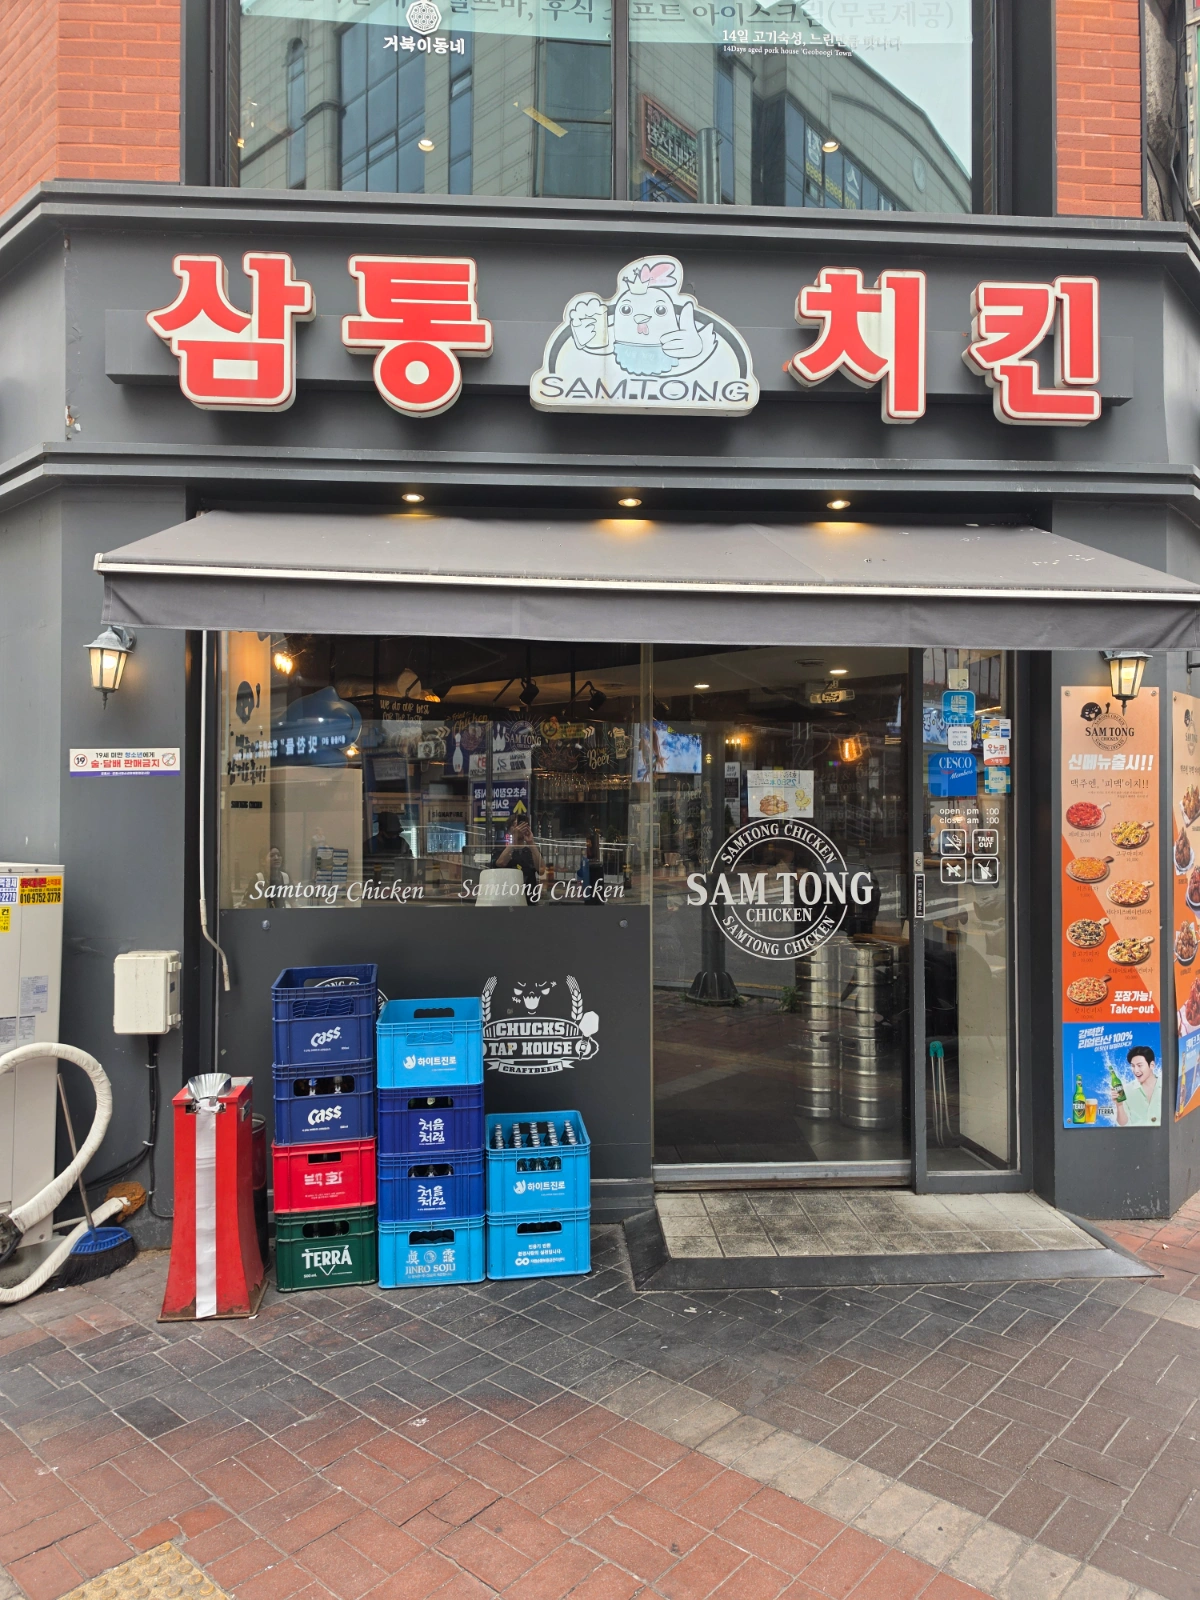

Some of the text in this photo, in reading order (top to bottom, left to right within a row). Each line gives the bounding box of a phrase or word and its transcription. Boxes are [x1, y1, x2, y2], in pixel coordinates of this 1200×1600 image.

[722, 30, 748, 43] 14일
[753, 31, 806, 47] 고기숙성,
[383, 35, 465, 55] 거북이동네
[764, 47, 779, 56] pork
[146, 251, 1101, 425] 삼통 치킨
[540, 376, 750, 403] SAMTONG
[1085, 727, 1134, 737] SAM TONG
[125, 751, 155, 759] 청소년에게
[586, 749, 610, 769] Beer
[124, 759, 160, 768] 판매금지
[939, 757, 972, 769] CESCO
[1068, 754, 1154, 771] 신메뉴출시!!
[940, 808, 960, 816] open
[721, 823, 837, 865] SAMTONG CHICKEN
[250, 879, 424, 904] Samtong Chicken
[458, 878, 625, 904] Samtong Chicken
[686, 871, 874, 906] SAM TONG
[746, 907, 813, 922] CHICKEN
[722, 915, 836, 956] SAMTONG CHICKEN
[1114, 991, 1153, 1002] 포장가능!
[1110, 1003, 1154, 1014] Take-out
[496, 1022, 565, 1036] CHUCKS
[1113, 1031, 1133, 1043] 100%
[489, 1042, 572, 1056] TAP HOUSE
[417, 1056, 456, 1067] 하이트진로
[502, 1065, 559, 1074] CRAFTBEER
[418, 1118, 445, 1131] 처음
[418, 1131, 445, 1143] 처럼
[417, 1185, 443, 1197] 처음
[527, 1181, 566, 1191] 하이트진로
[417, 1197, 446, 1206] 처럼
[404, 1263, 455, 1275] JINRO SOJU
